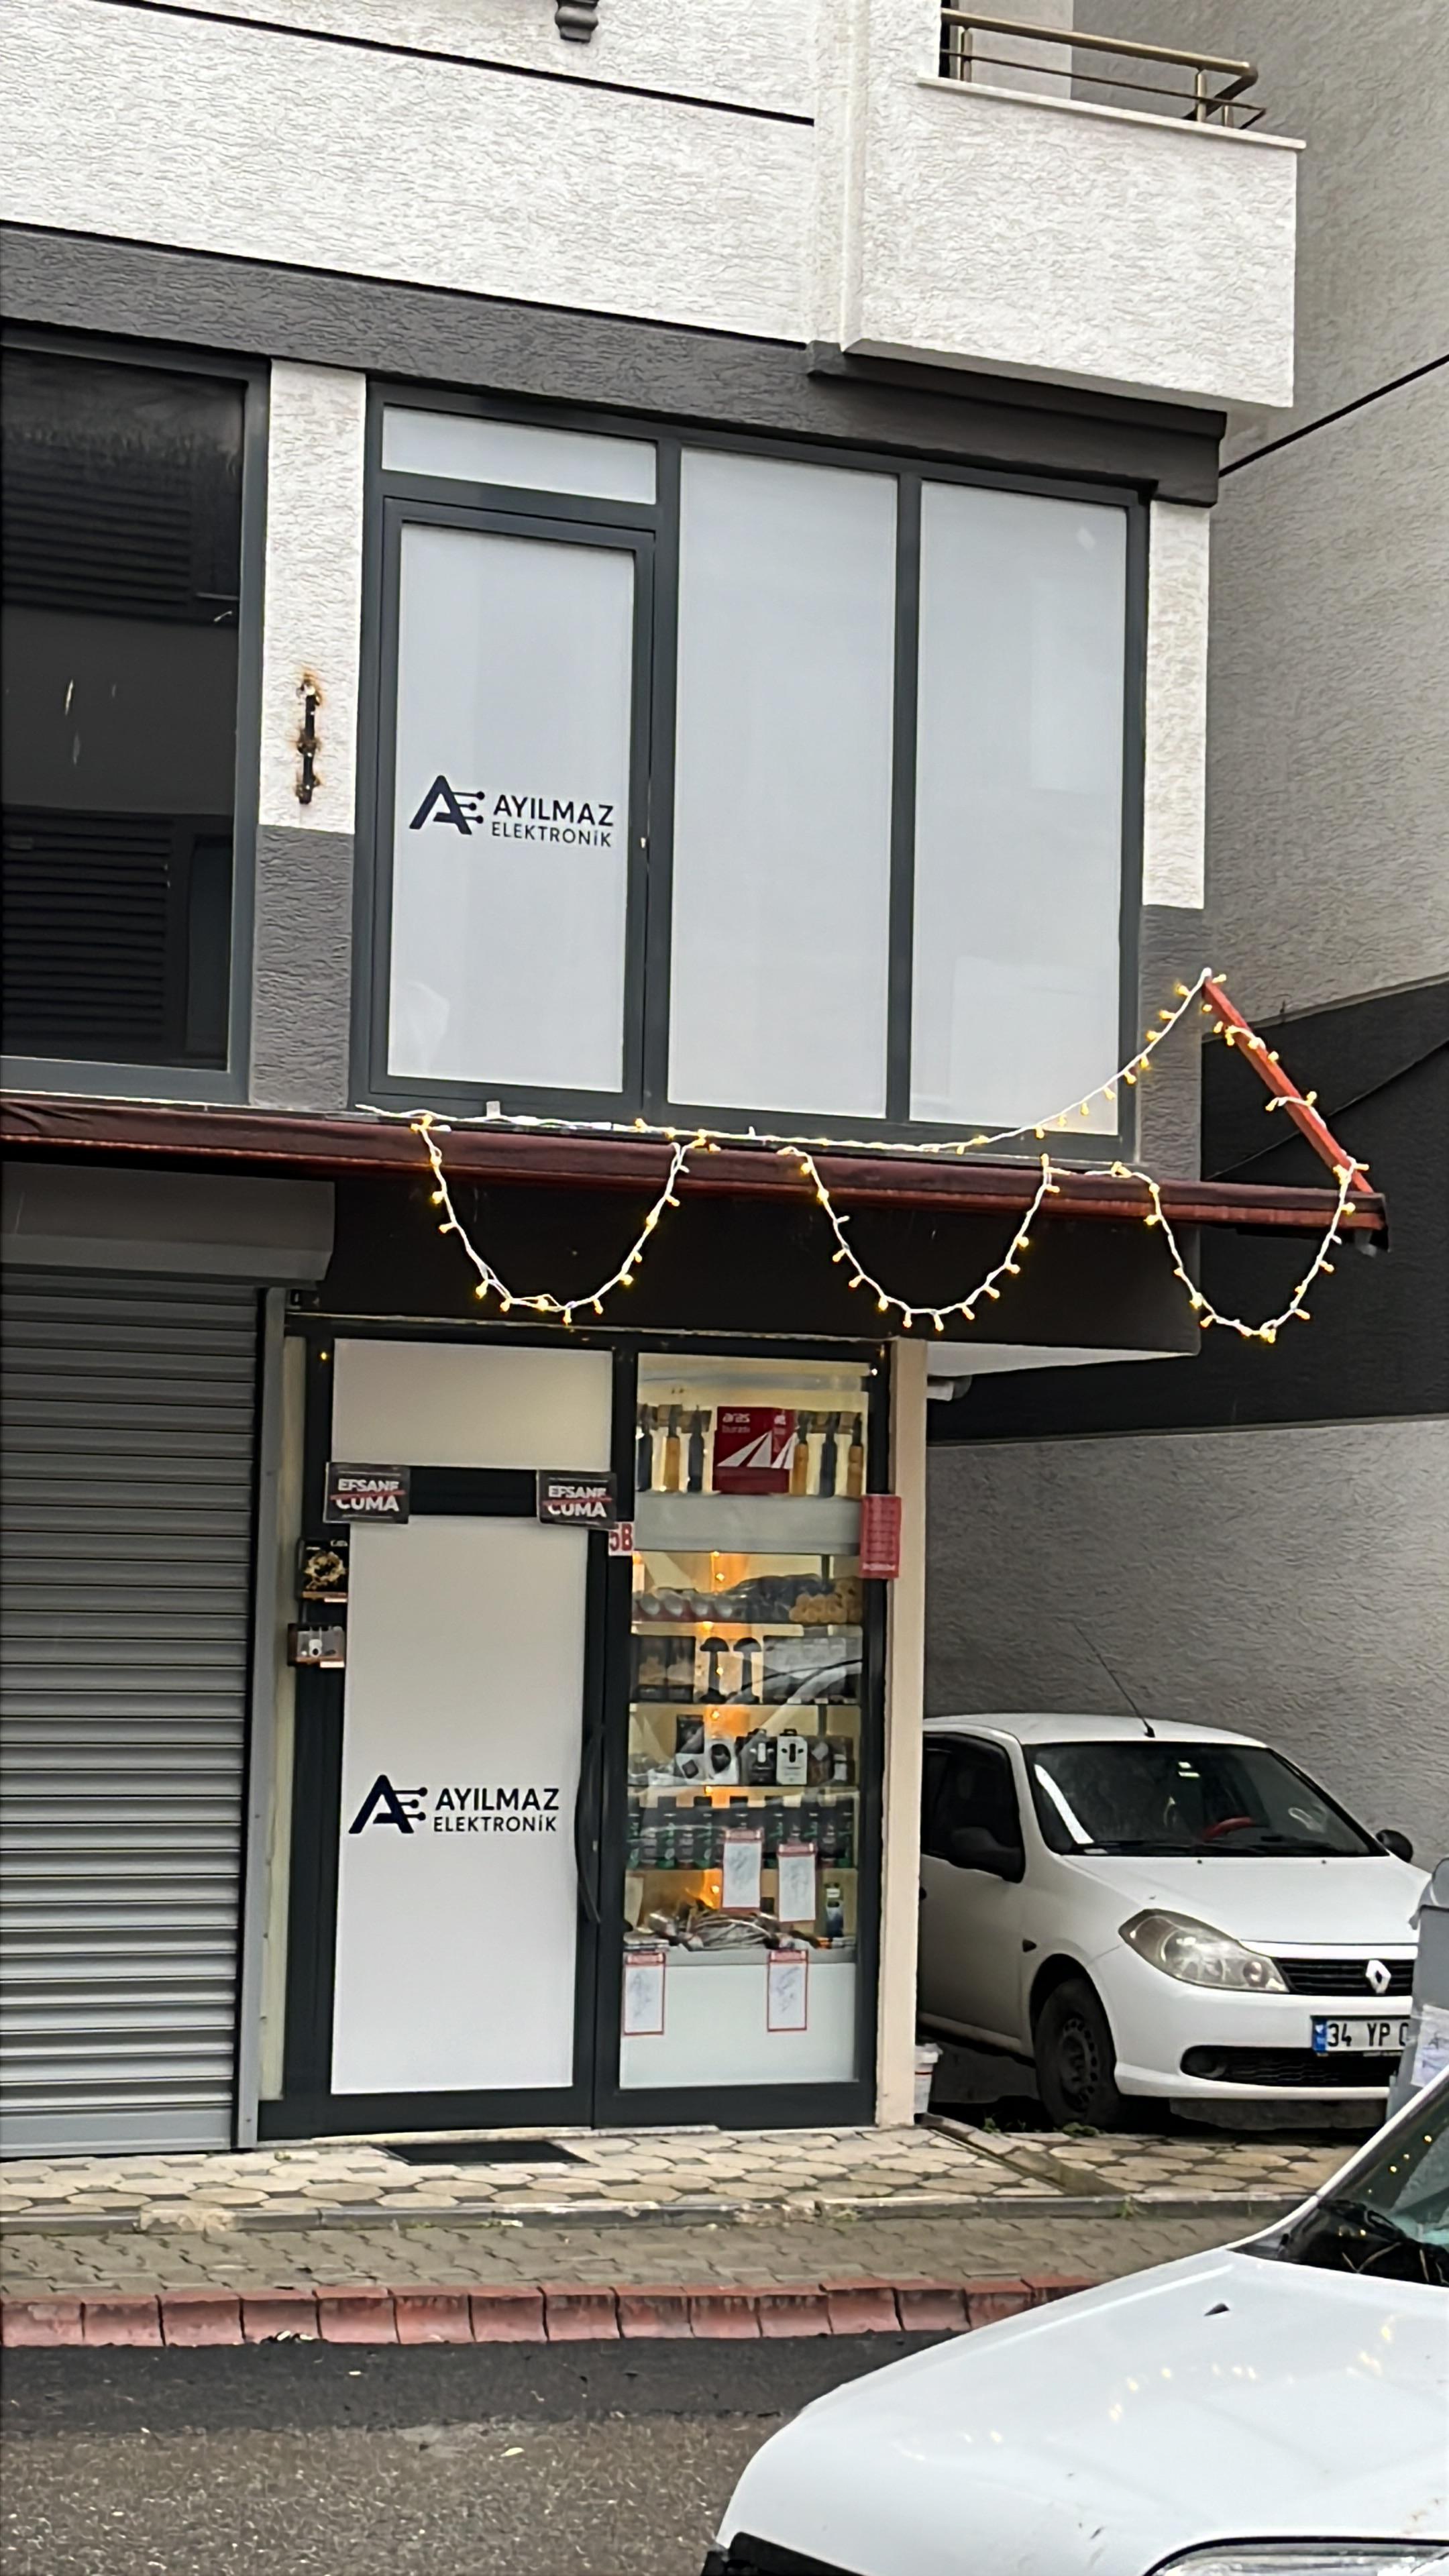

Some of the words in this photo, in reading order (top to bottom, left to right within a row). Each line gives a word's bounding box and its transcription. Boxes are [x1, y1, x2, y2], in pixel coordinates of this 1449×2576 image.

[493, 794, 614, 826] AYILMAZ
[491, 821, 612, 847] ELEKTRONİK
[337, 1478, 400, 1493] EFSANE
[548, 1485, 607, 1499] EFSANE
[335, 1494, 400, 1512] CUMA
[547, 1500, 607, 1518] CUMA
[609, 1523, 633, 1552] 5B
[435, 1787, 560, 1811] AYILMAZ
[433, 1814, 557, 1833] ELEKTRONİK
[1327, 2023, 1352, 2047] 34
[1366, 2022, 1391, 2047] YP
